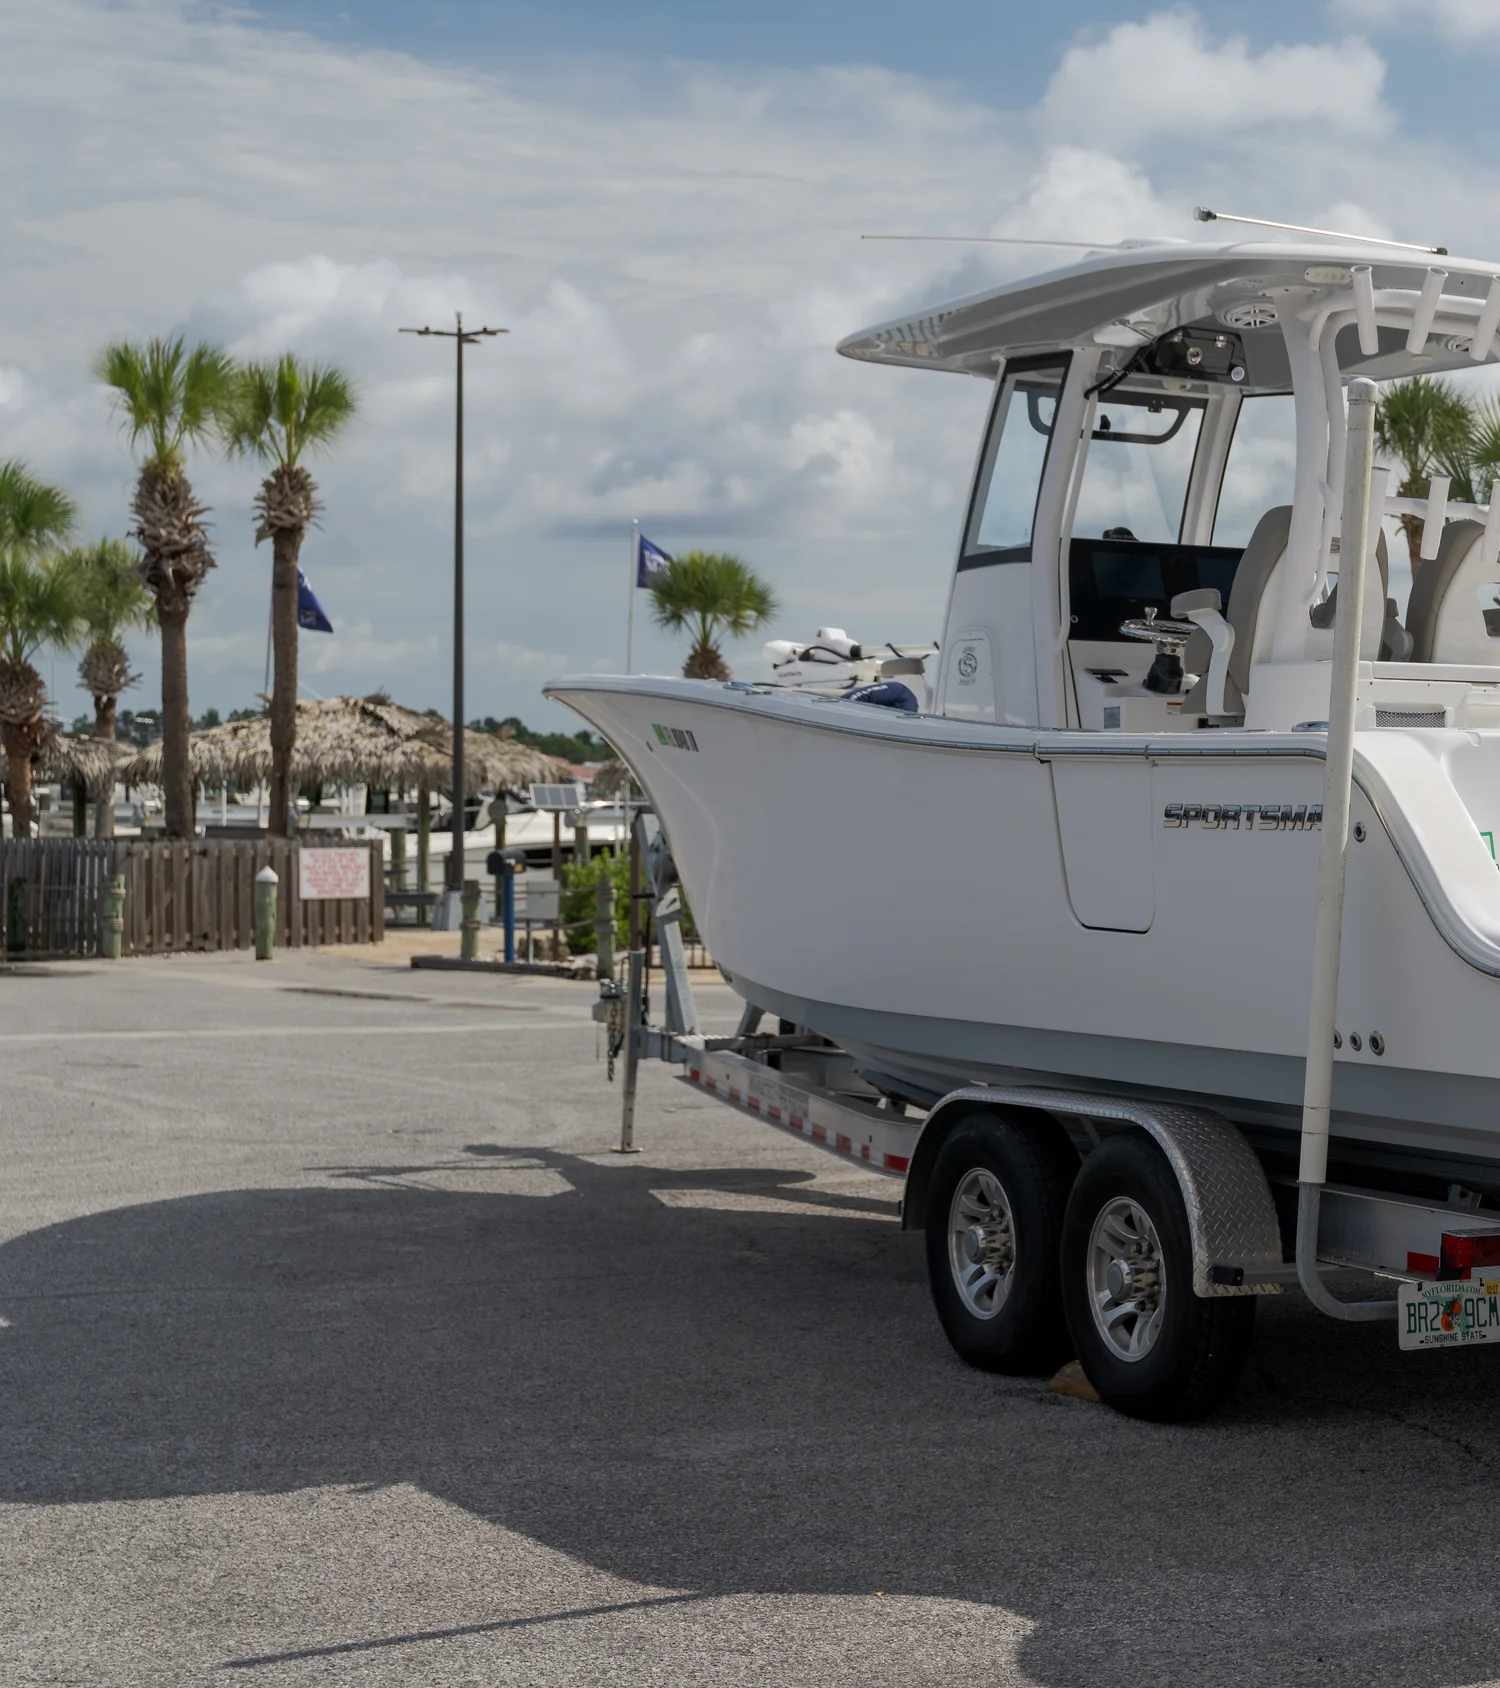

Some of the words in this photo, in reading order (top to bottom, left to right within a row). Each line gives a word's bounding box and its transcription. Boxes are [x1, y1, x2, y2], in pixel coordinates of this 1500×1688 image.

[1163, 803, 1324, 831] SPORTSMA
[1424, 1332, 1458, 1344] SUNSHINE
[1461, 1331, 1483, 1341] STATE
